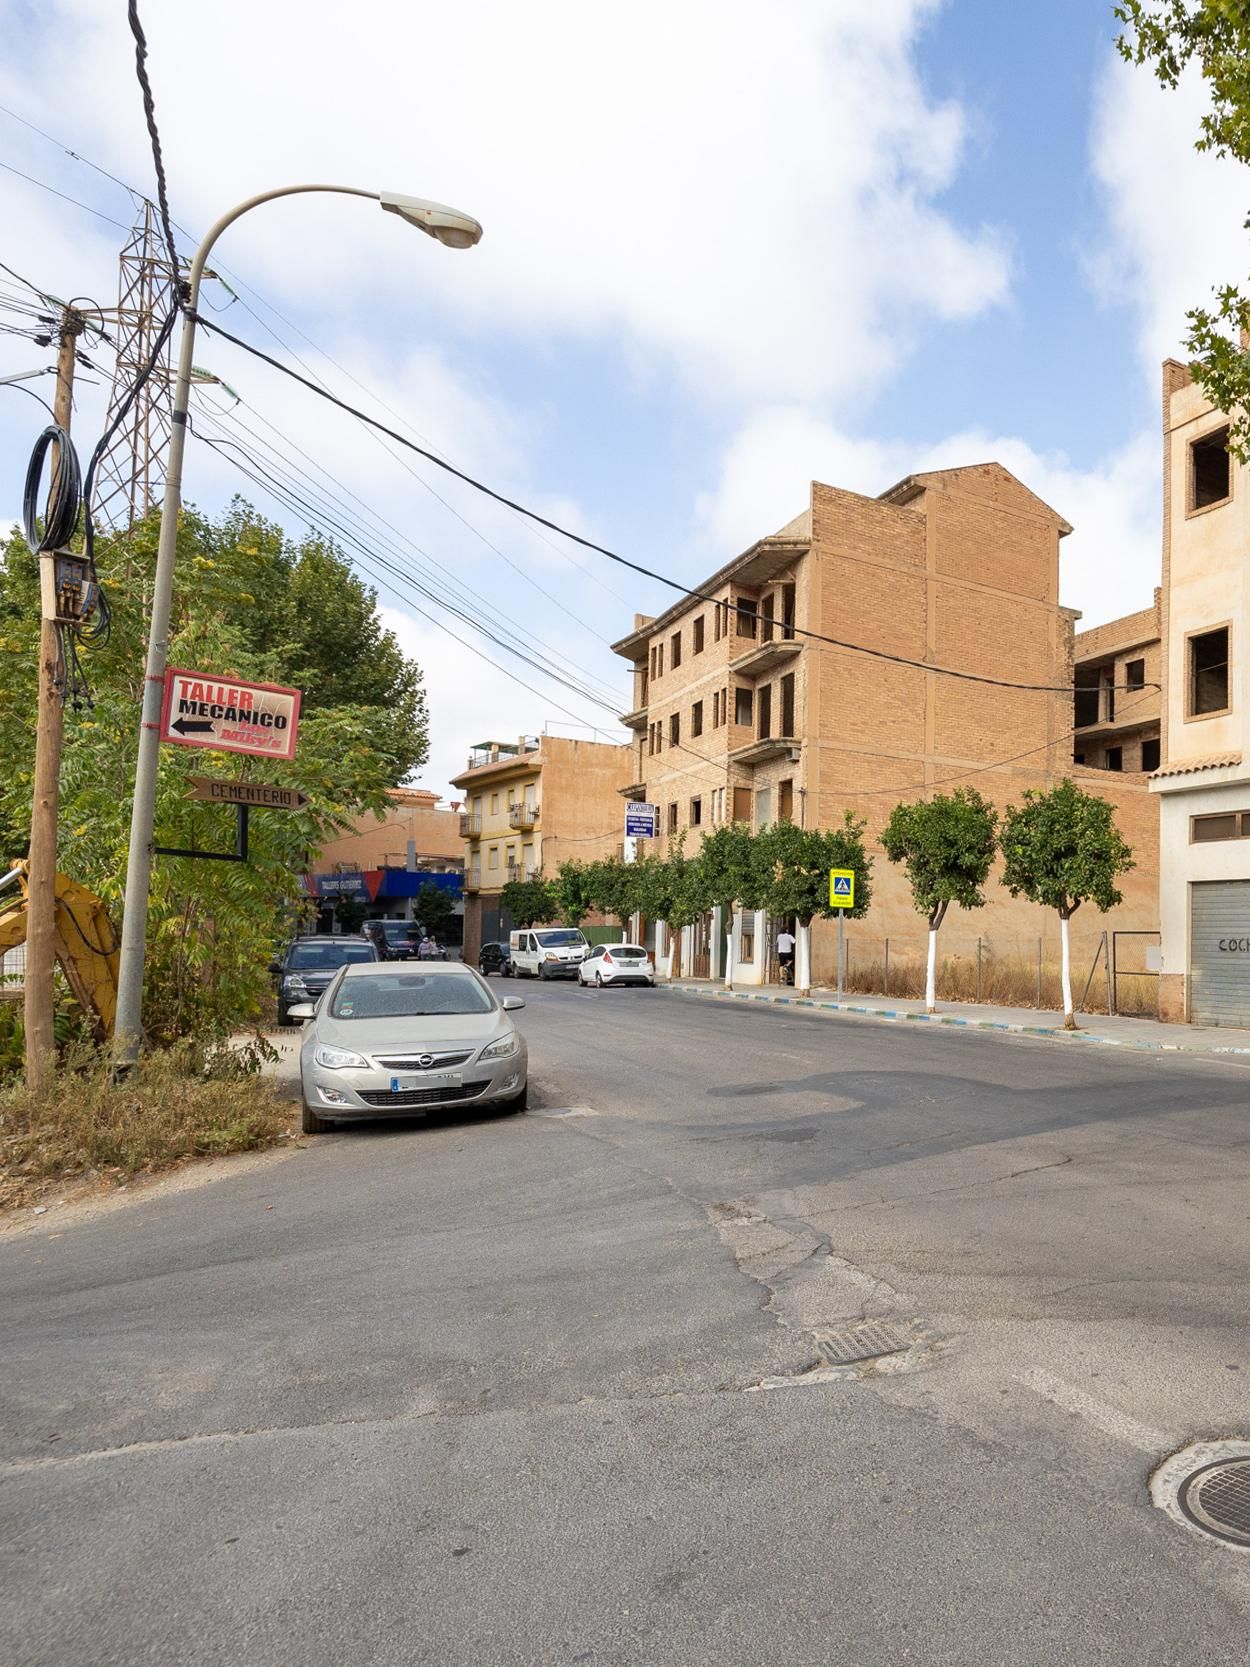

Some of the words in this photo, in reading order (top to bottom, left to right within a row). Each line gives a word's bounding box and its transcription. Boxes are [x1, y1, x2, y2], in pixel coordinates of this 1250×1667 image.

[179, 680, 253, 710] TALLER
[178, 698, 287, 730] MECÁNICO
[211, 783, 291, 805] CEMENTERIO
